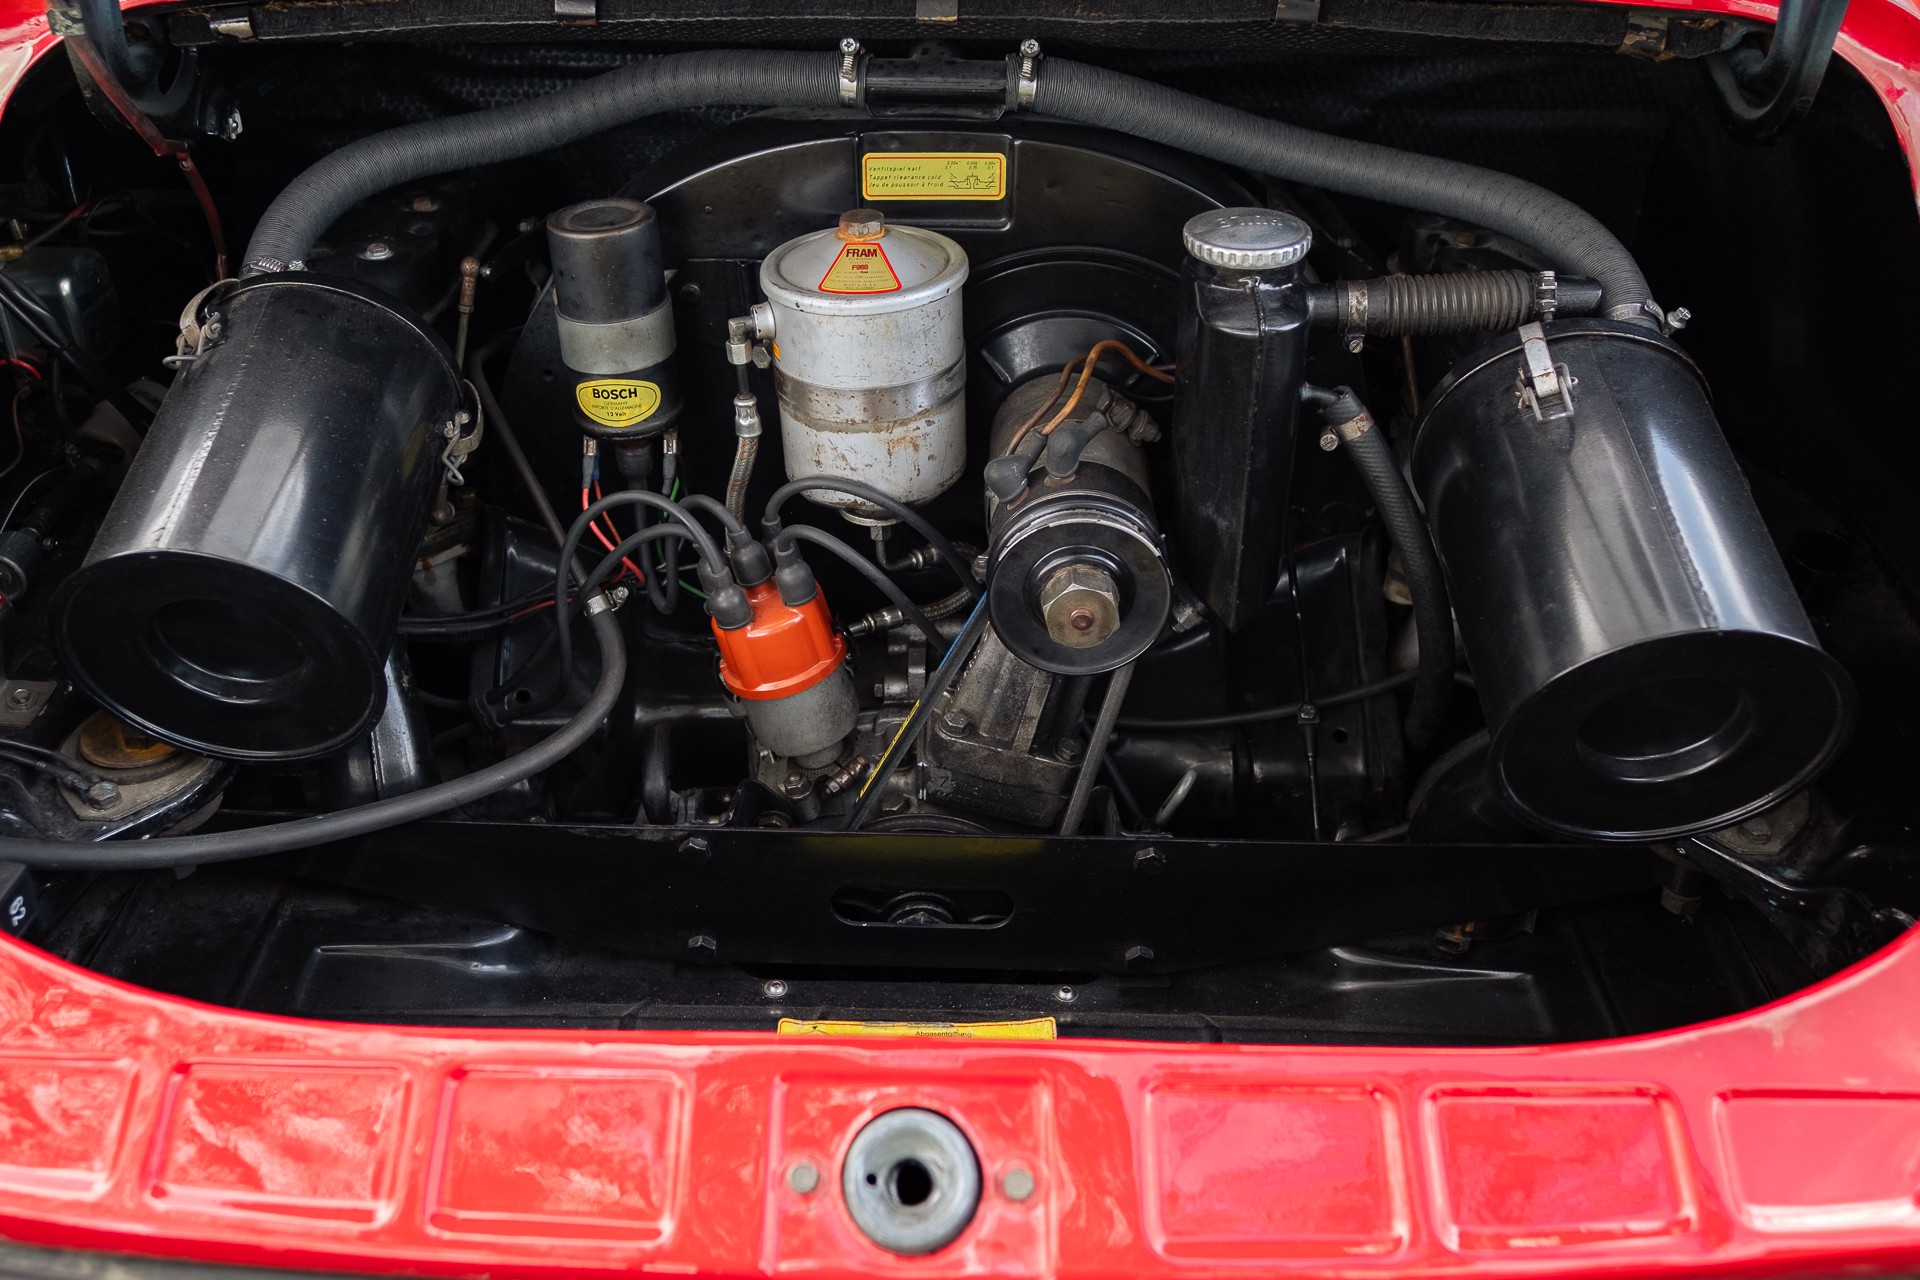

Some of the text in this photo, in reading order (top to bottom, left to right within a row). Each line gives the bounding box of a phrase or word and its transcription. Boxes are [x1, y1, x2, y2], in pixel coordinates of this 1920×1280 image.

[846, 248, 878, 258] FRAM
[592, 388, 638, 400] BOSCH
[9, 895, 26, 927] 62
